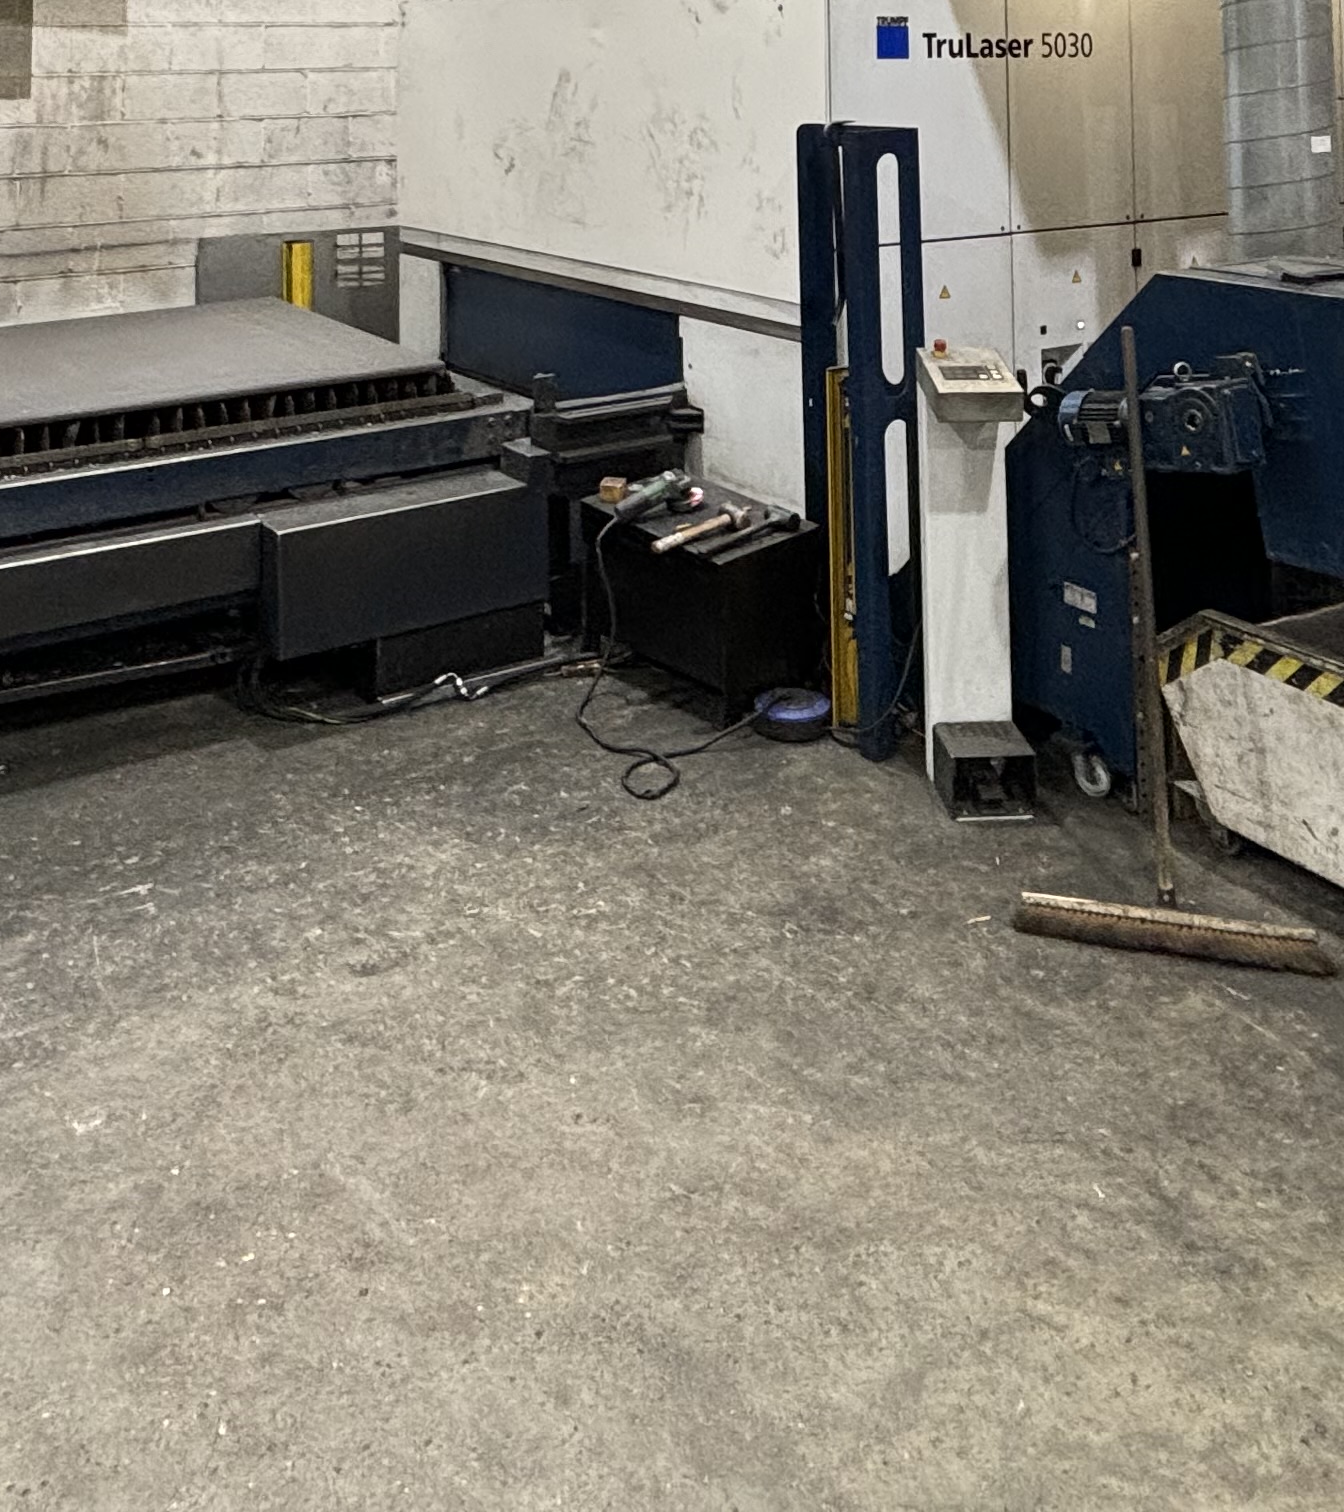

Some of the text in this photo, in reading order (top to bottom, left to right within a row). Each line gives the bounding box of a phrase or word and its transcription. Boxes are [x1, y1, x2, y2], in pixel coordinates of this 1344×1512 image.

[876, 16, 909, 26] TRUMPF
[922, 33, 1093, 59] TruLaser 5030
